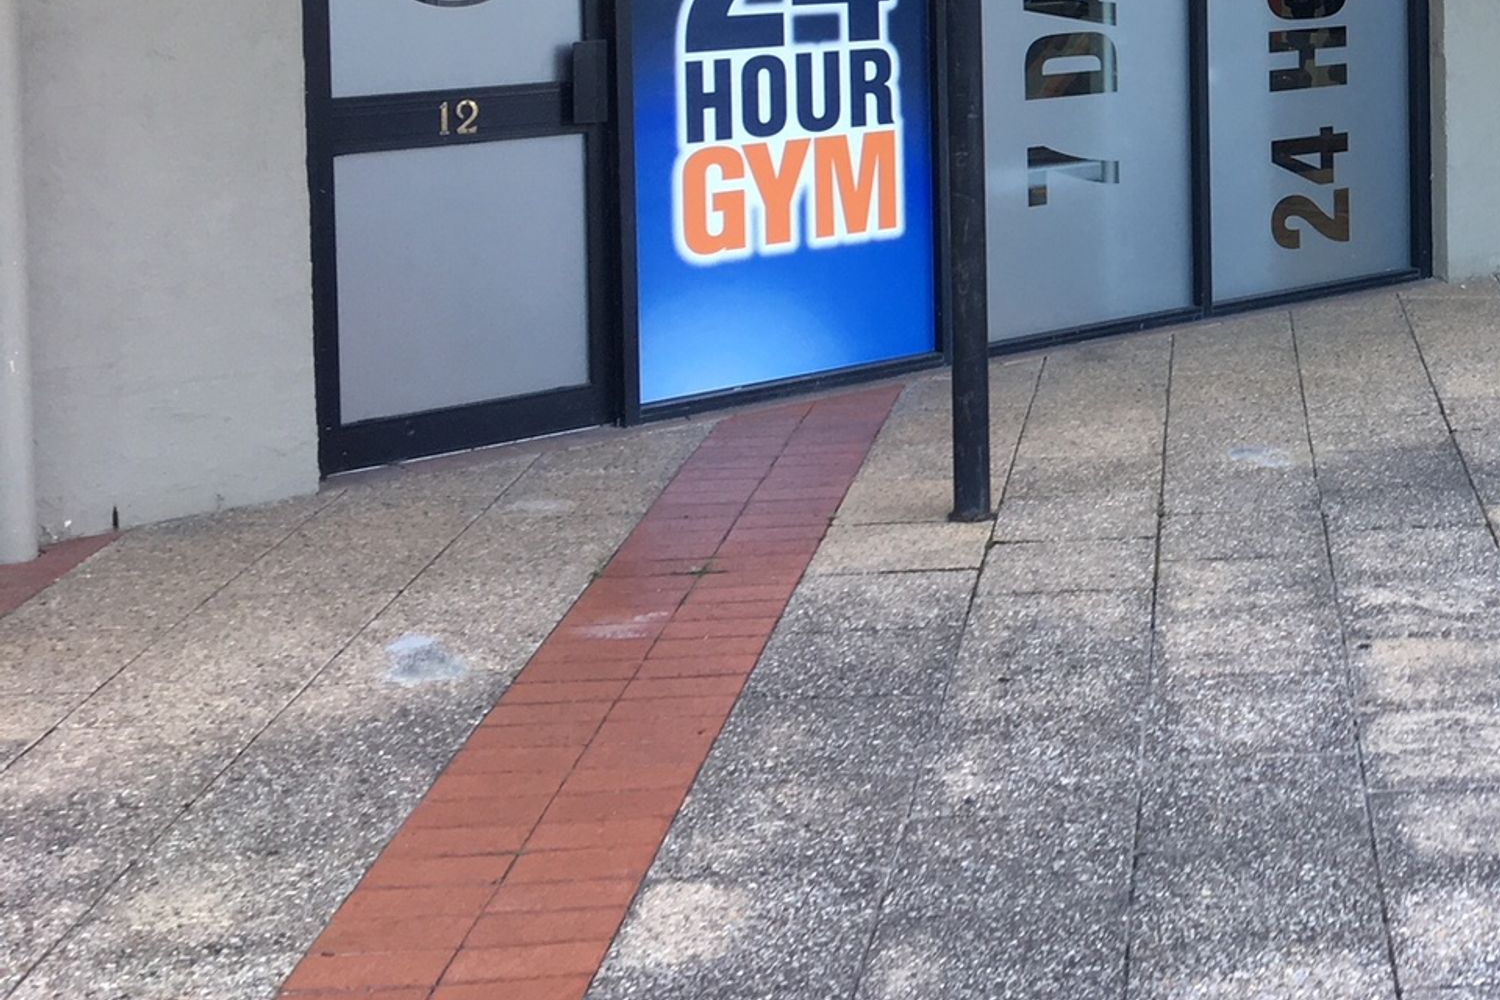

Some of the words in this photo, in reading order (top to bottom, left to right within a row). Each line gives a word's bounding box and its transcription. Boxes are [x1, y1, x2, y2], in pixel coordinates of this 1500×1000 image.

[439, 100, 480, 136] 12
[684, 47, 895, 143] HOUR
[681, 130, 898, 257] GYM
[1027, 145, 1120, 207] 7
[1270, 126, 1351, 250] 24
